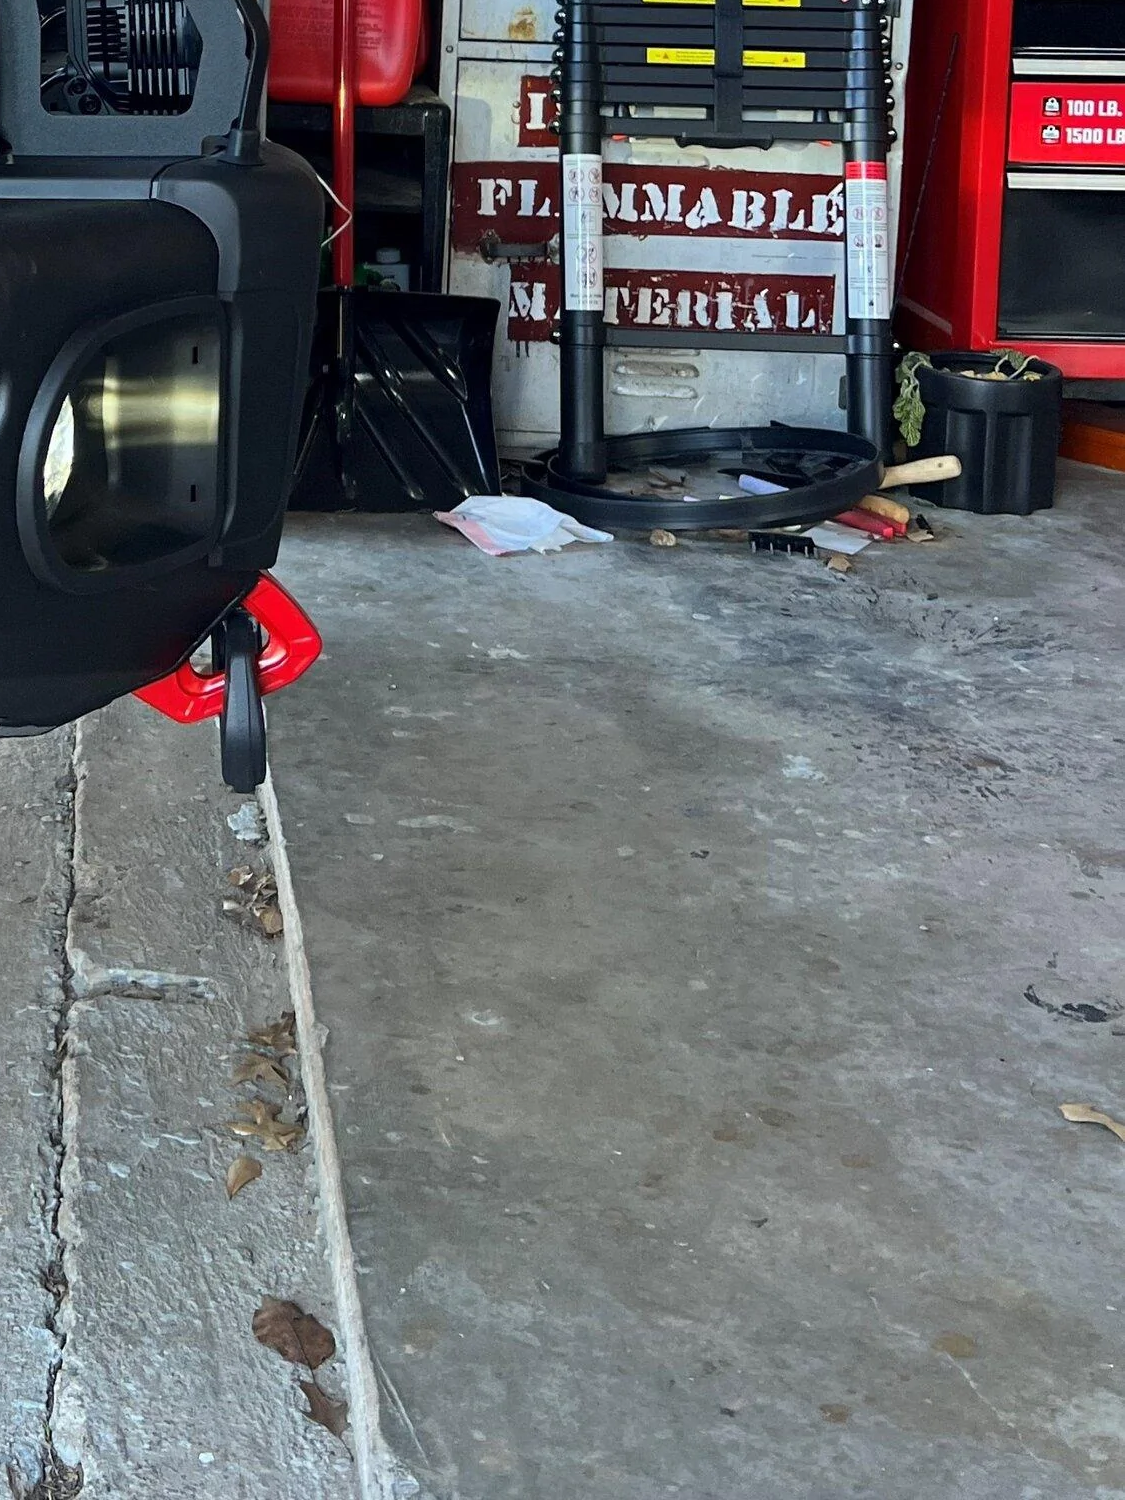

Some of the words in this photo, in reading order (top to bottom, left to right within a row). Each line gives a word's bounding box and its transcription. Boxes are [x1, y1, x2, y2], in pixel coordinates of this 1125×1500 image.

[1067, 99, 1095, 117] 100
[1098, 100, 1123, 117] LB.
[1066, 127, 1104, 145] 1500
[477, 178, 844, 236] FLMMABLE
[509, 281, 816, 332] MTERIAL
